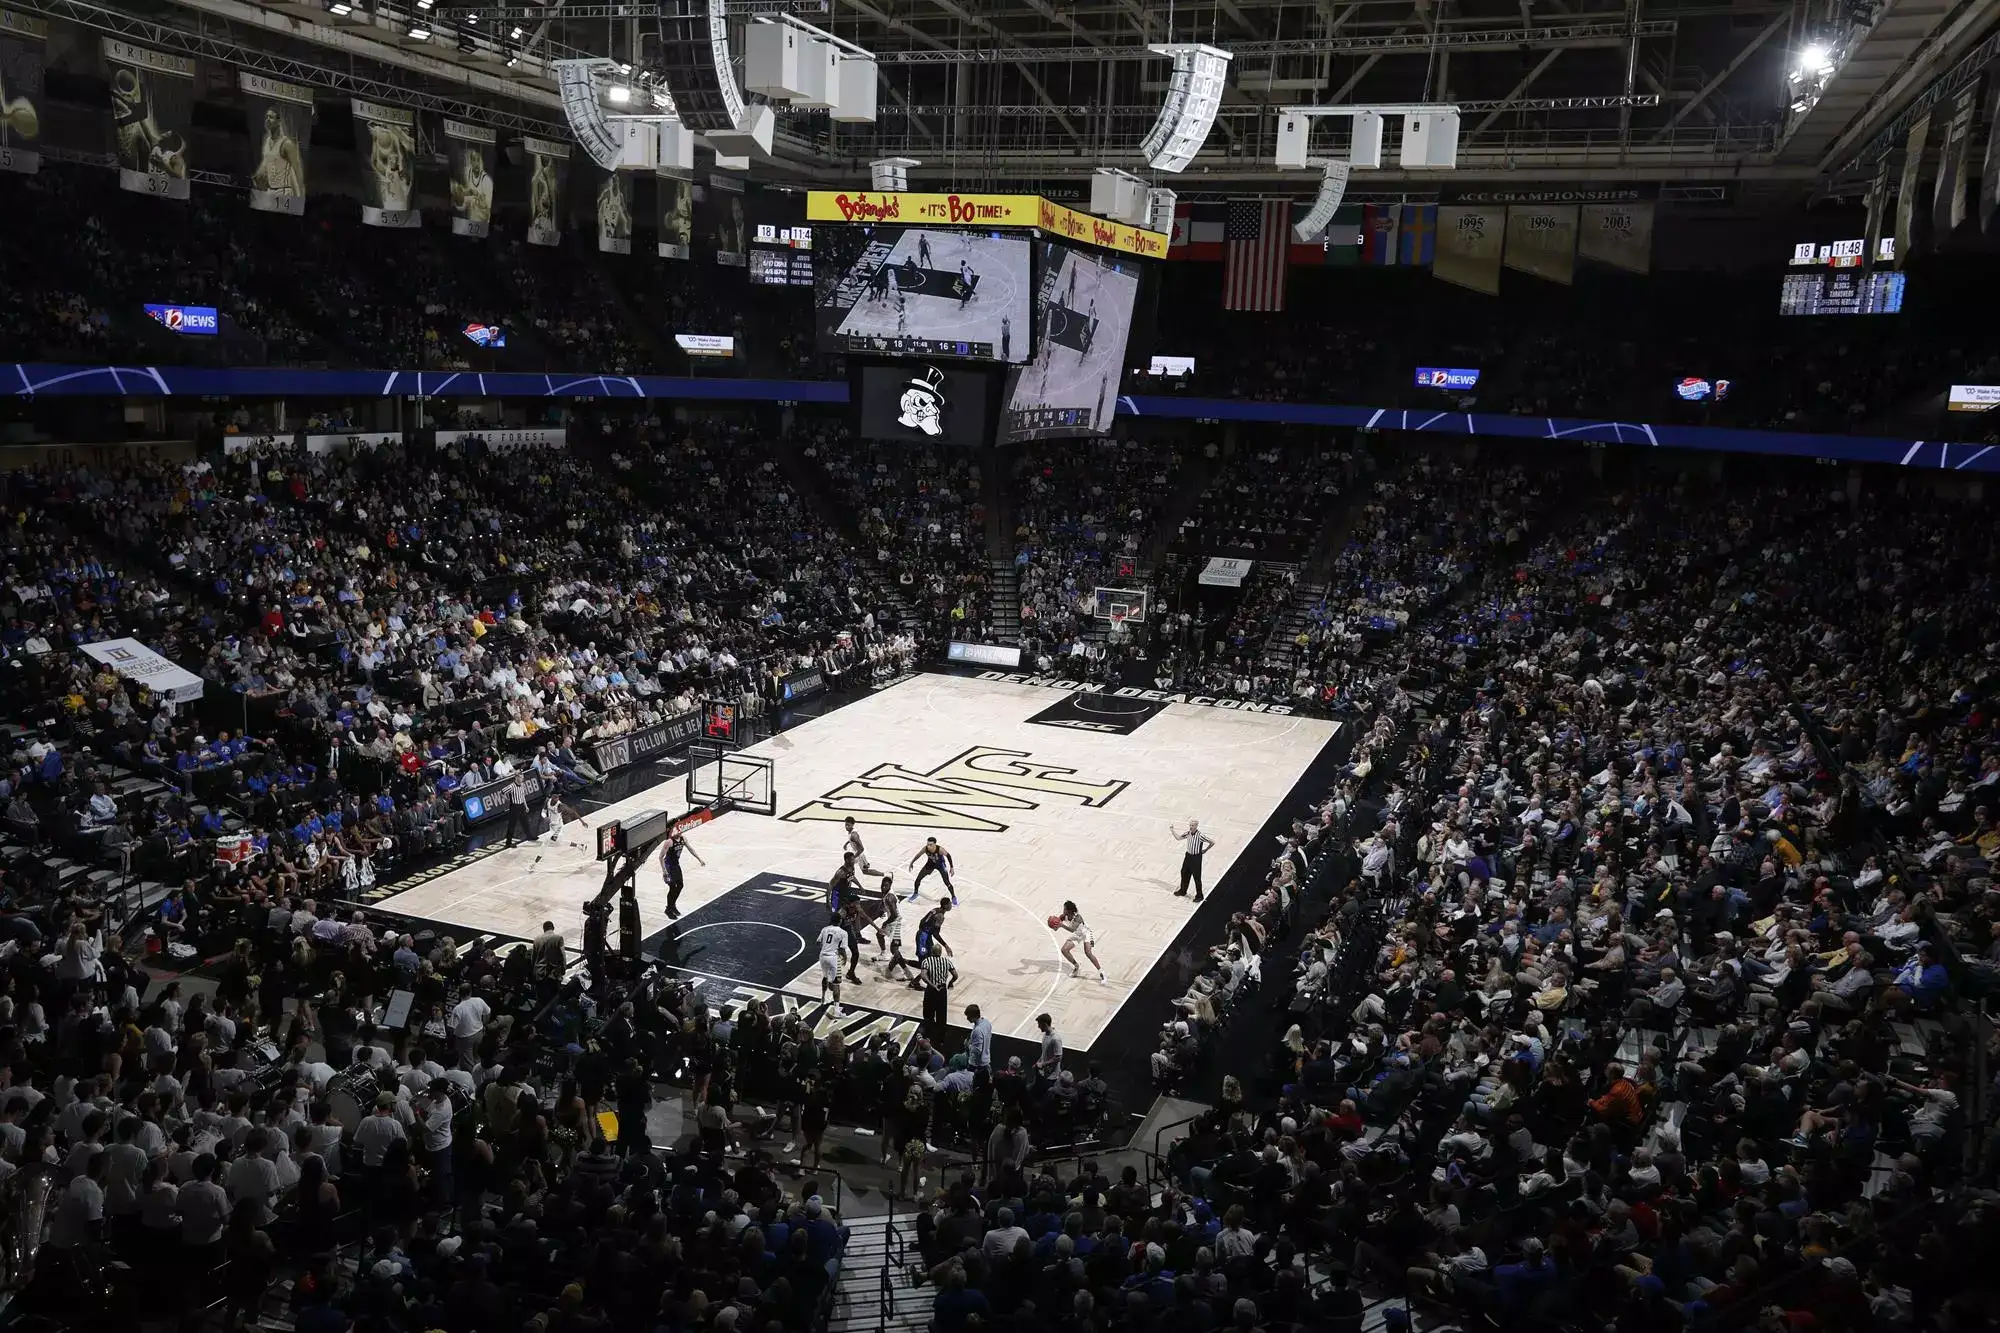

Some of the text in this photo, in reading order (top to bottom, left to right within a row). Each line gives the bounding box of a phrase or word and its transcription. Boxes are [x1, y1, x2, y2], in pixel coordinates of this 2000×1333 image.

[148, 179, 169, 194] 32
[1456, 190, 1640, 201] ACC CHAMPIONSHIPS
[275, 197, 291, 210] 14
[928, 195, 1003, 222] IT'S BO TIME!
[381, 212, 400, 225] 54
[1458, 217, 1485, 230] 1995
[1530, 216, 1556, 229] 1996
[1602, 216, 1632, 229] 2003
[762, 227, 772, 236] 18
[1134, 229, 1146, 253] BO
[1799, 244, 1810, 258] 18
[1834, 241, 1861, 256] 11:48
[184, 314, 216, 328] NEWS
[1430, 370, 1448, 386] 12
[1447, 375, 1477, 385] NEWS
[501, 432, 545, 442] FOREST
[975, 669, 1295, 716] DEMON DEACONS
[633, 731, 668, 755] FOLLOW
[669, 724, 685, 742] THE
[826, 933, 833, 944] 0
